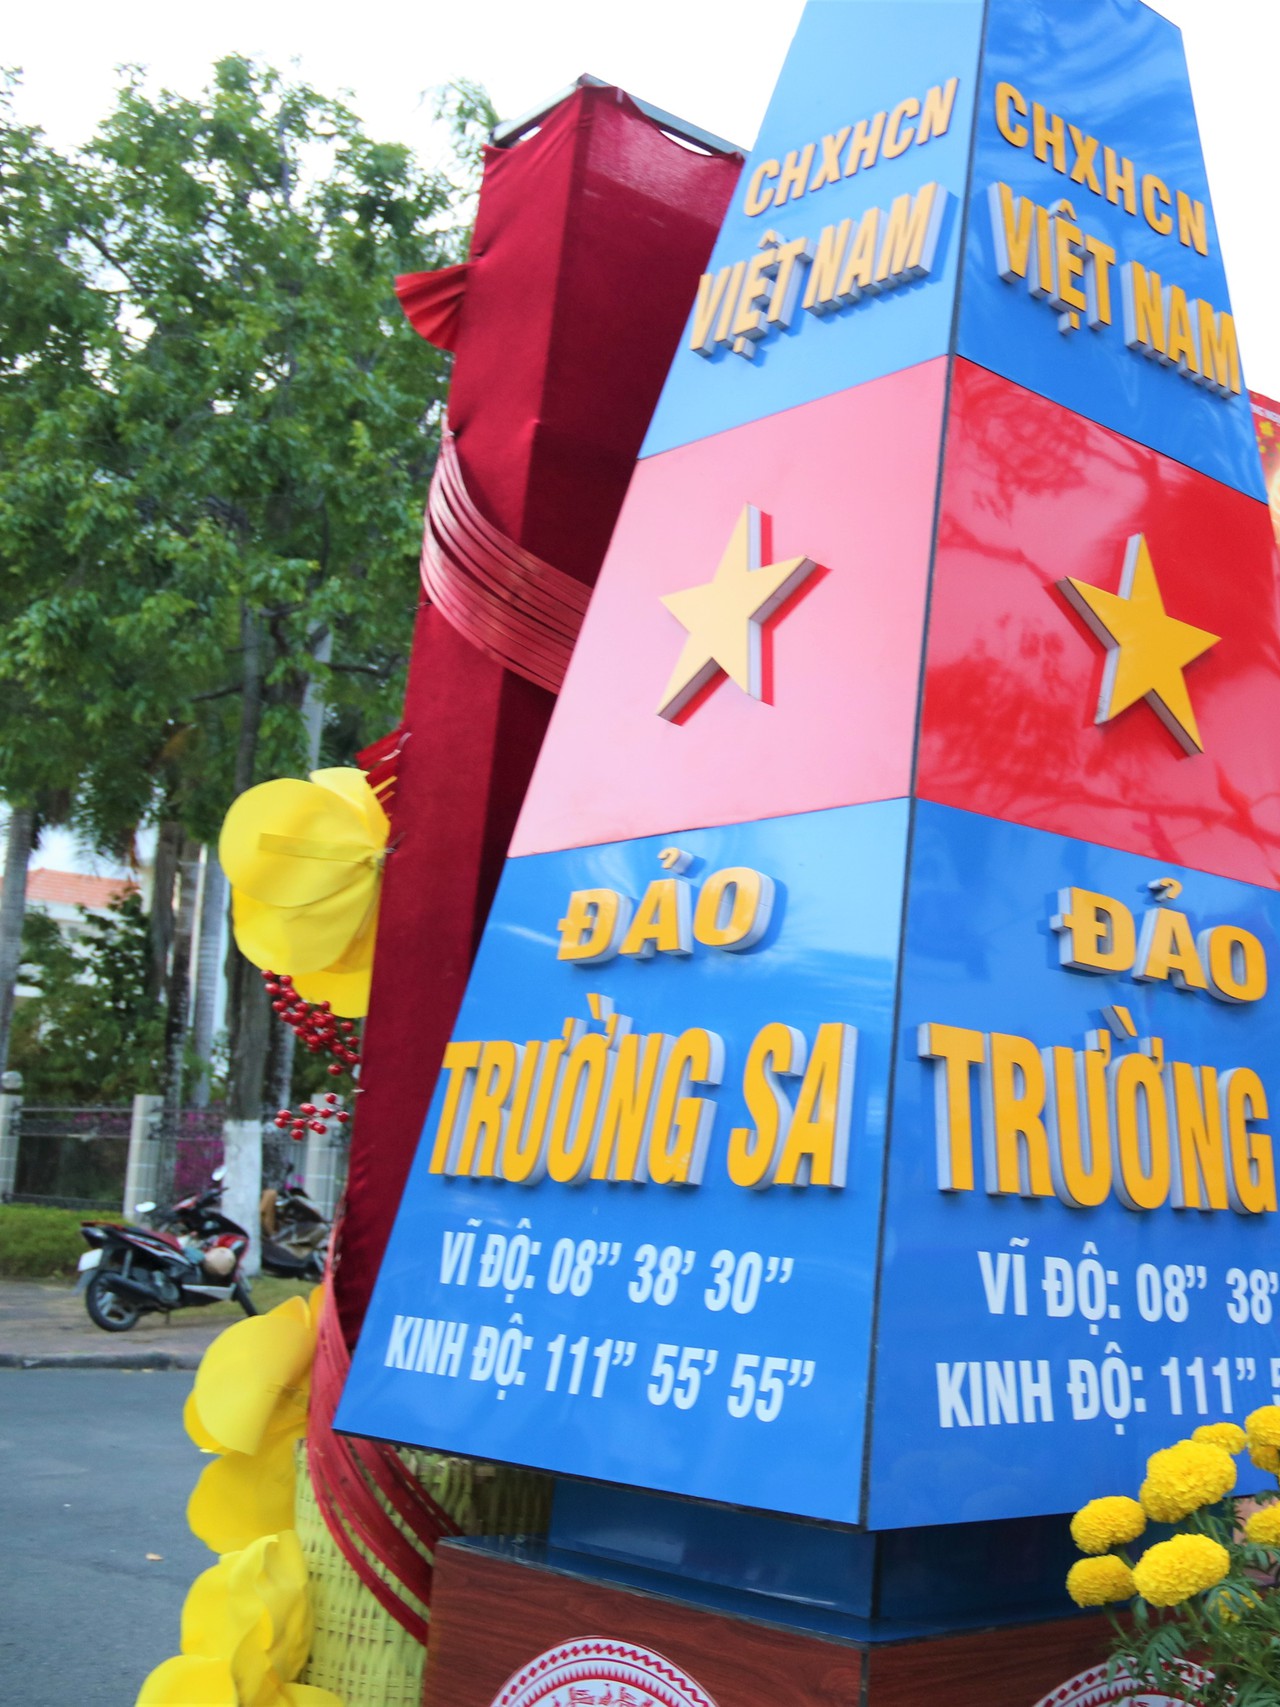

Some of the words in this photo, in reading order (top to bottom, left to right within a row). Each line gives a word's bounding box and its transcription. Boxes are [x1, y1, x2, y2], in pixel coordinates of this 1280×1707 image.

[745, 78, 959, 217] CHXHCN
[995, 81, 1208, 256] CHXHCN
[689, 228, 813, 359] VIỆT
[801, 182, 947, 316] NAM
[988, 180, 1117, 336] VIỆT
[1118, 259, 1243, 401] NAM
[556, 846, 775, 966] ĐẢO
[1050, 876, 1269, 1004] ĐẢO
[427, 992, 726, 1187] TRƯỜNG
[725, 1021, 858, 1190] SA
[917, 1004, 1280, 1216] TRƯỜNG
[438, 1217, 484, 1286] VĨ
[478, 1219, 541, 1304] ĐỘ:
[976, 1236, 1030, 1317] VĨ
[1041, 1240, 1122, 1336] ĐỘ:
[384, 1313, 468, 1379] KINH
[469, 1313, 533, 1401] ĐỘ:
[935, 1359, 1056, 1429] KINH
[1066, 1341, 1146, 1436] ĐỘ:
